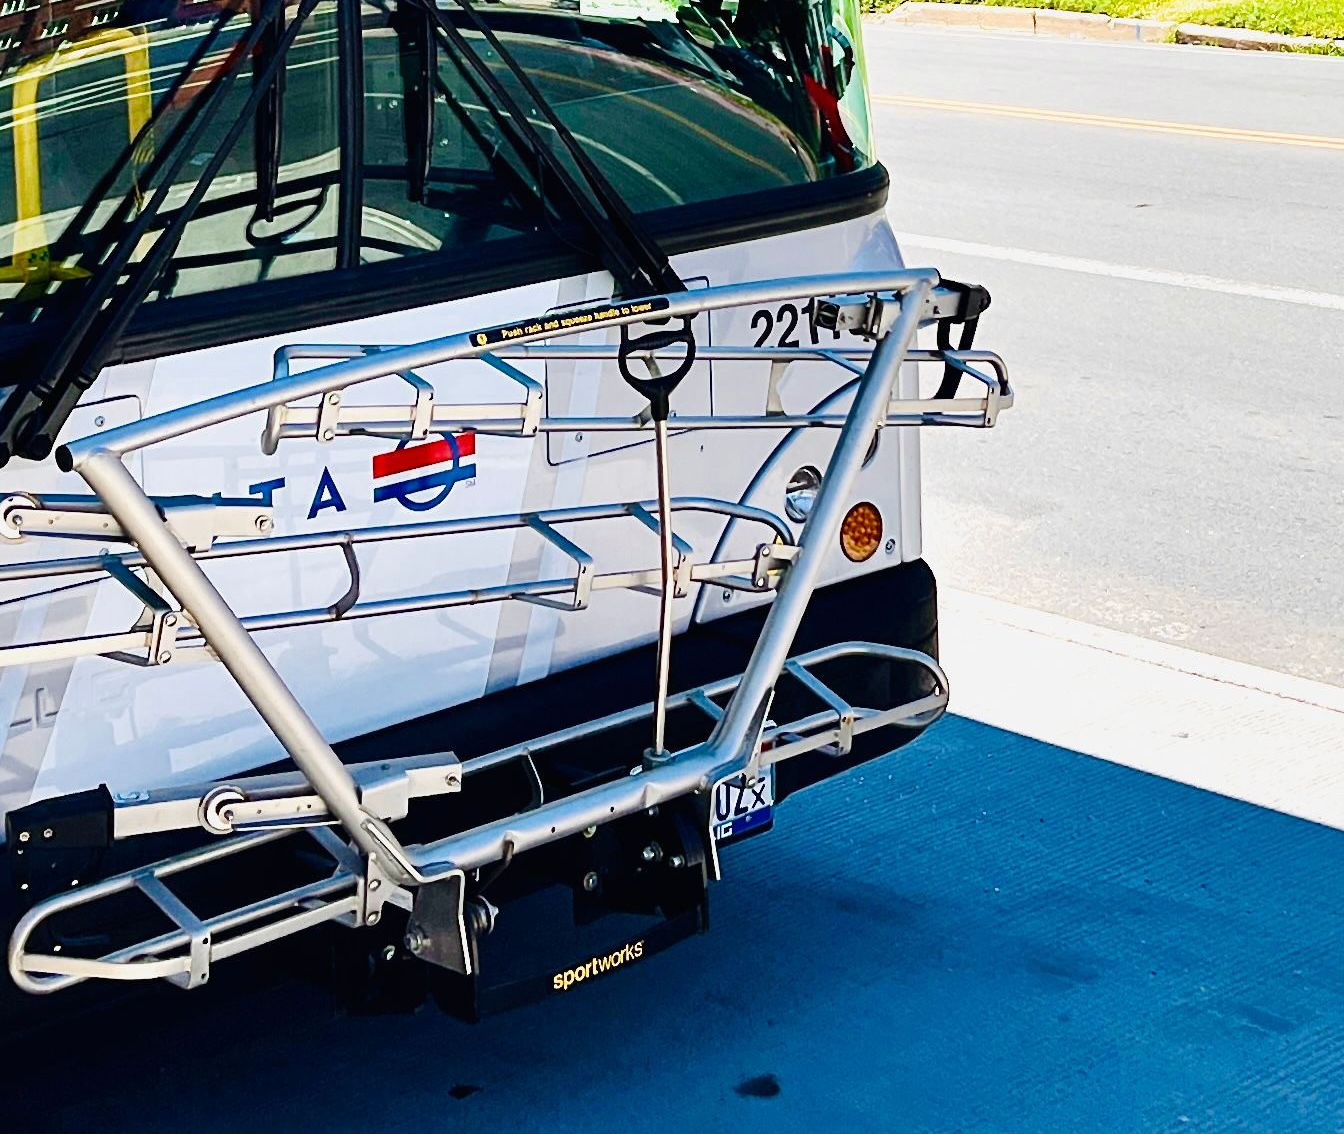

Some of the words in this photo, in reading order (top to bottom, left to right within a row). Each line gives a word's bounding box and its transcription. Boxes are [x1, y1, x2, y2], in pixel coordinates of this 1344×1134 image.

[502, 325, 523, 339] Push
[525, 319, 543, 333] rack
[544, 318, 559, 330] and
[621, 304, 630, 316] to
[553, 939, 644, 991] sportworks
